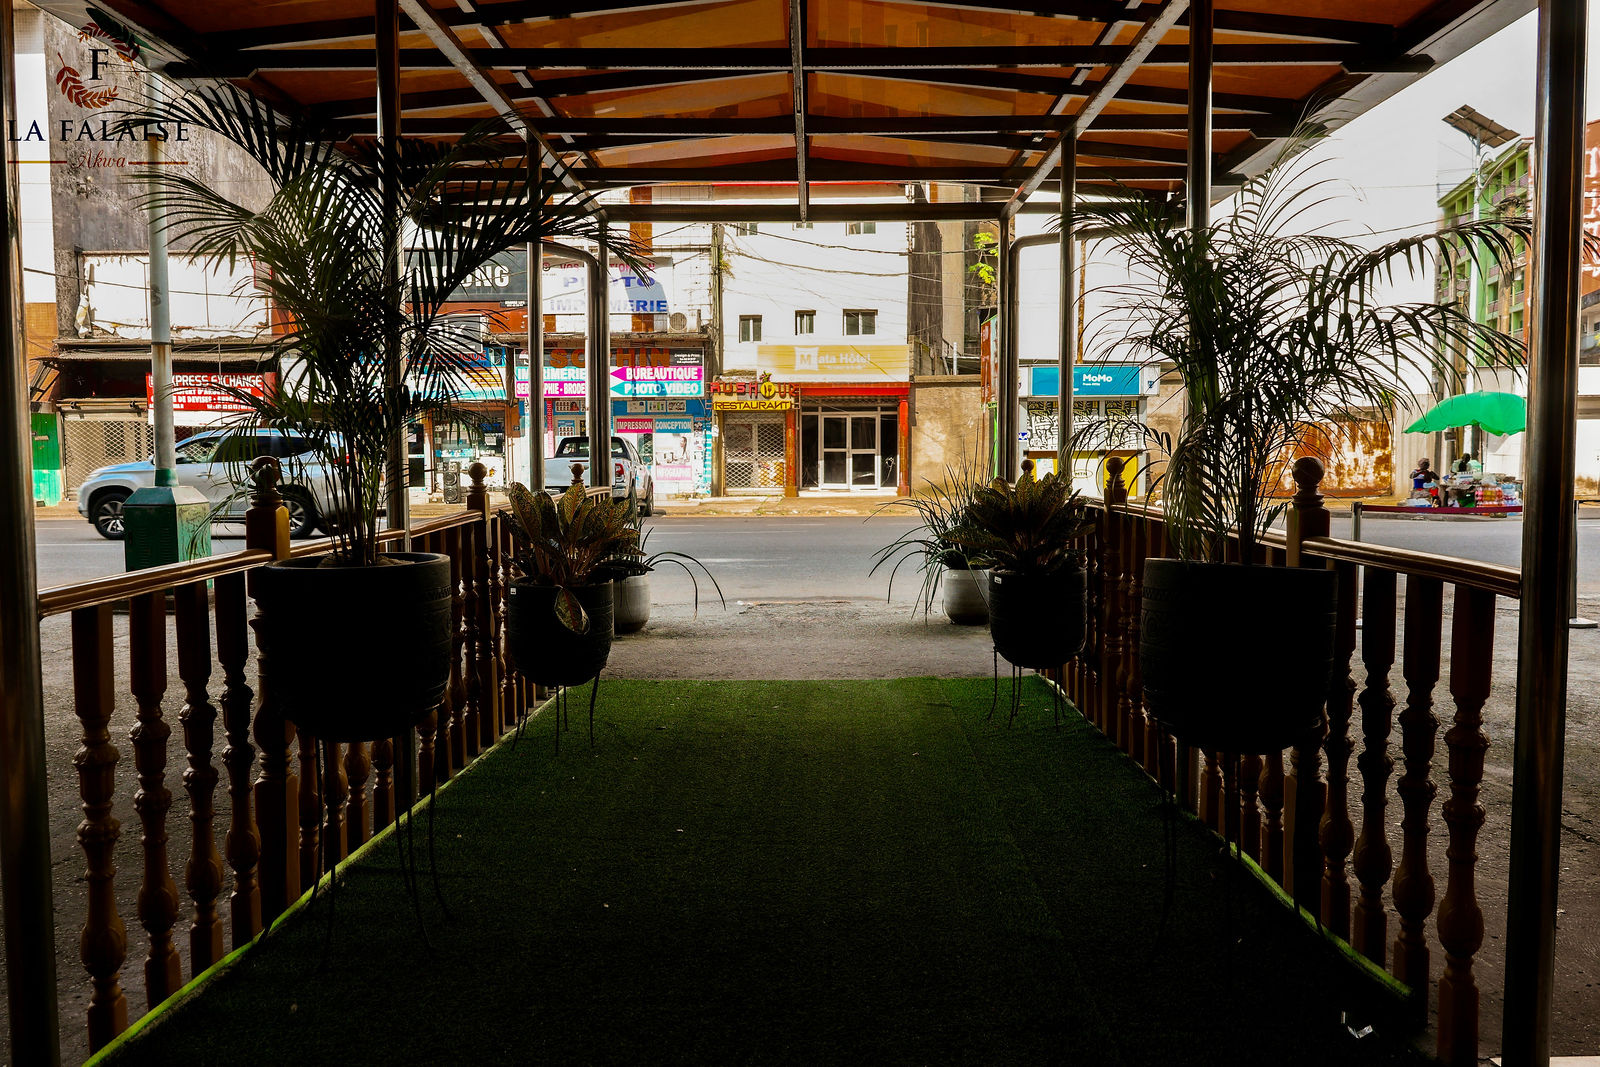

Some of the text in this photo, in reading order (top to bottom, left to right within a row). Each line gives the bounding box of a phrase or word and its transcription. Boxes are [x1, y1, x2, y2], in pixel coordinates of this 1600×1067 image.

[626, 367, 698, 380] BUREAUTIQUE
[1082, 373, 1113, 383] MoMo
[211, 374, 264, 387] EXCHANGE
[715, 401, 790, 410] RESTAURANT
[617, 421, 692, 430] IMPRESSION CONCEPTION
